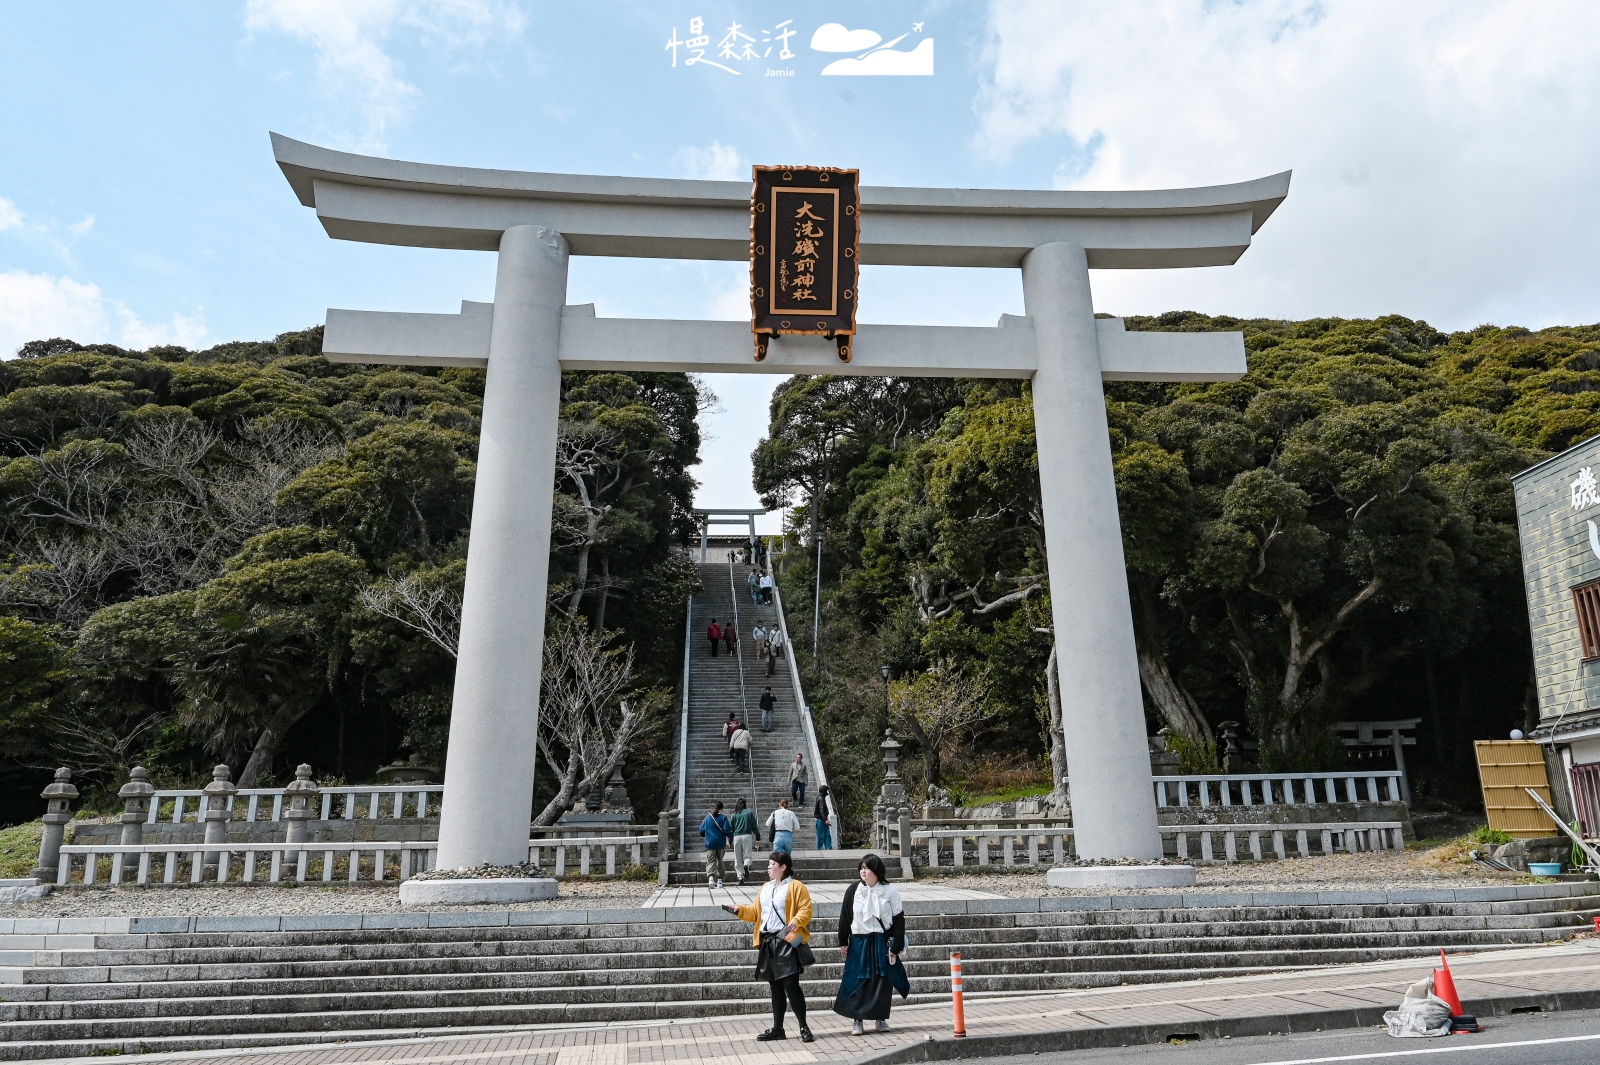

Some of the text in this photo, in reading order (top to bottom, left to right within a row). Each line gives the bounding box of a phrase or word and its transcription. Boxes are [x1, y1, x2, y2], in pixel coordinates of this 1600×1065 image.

[790, 200, 826, 301] 大洗磯前神社
